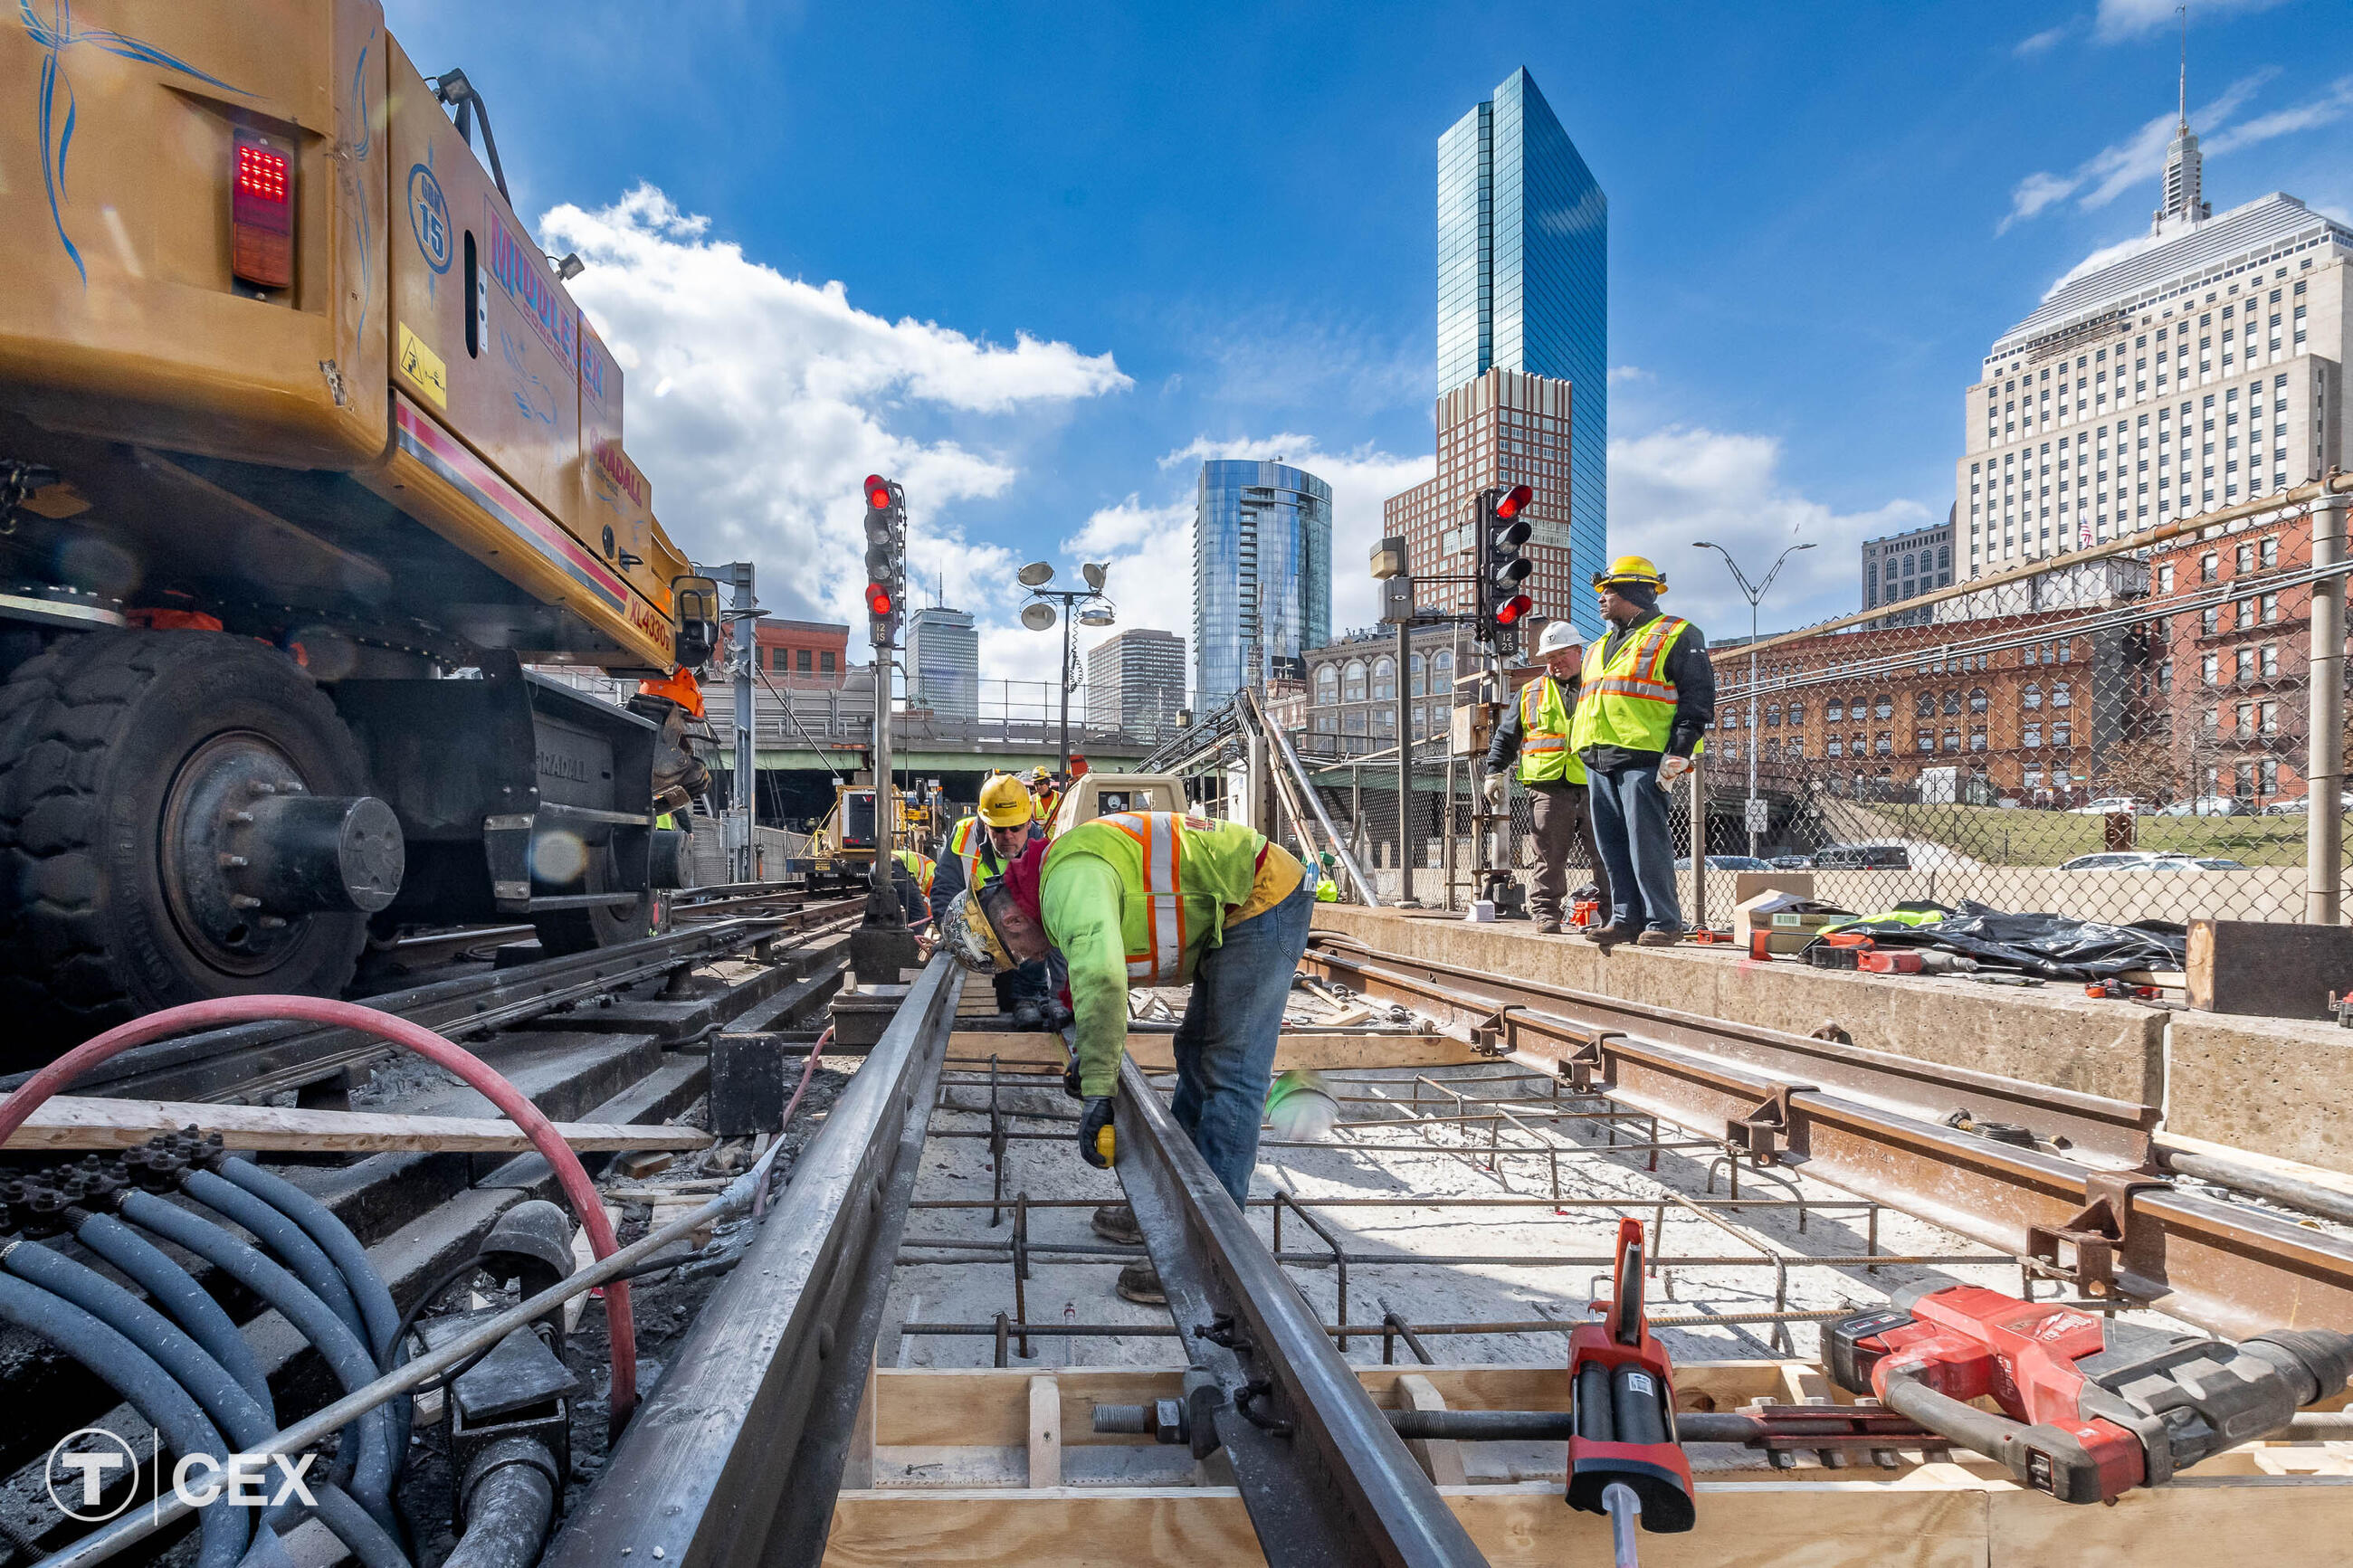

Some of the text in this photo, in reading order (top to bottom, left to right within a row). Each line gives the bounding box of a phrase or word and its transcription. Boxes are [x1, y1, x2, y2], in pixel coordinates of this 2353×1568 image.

[418, 201, 444, 261] 15
[491, 211, 603, 398] MIDDLESEX
[630, 598, 666, 647] XL4330
[876, 622, 886, 632] 12
[1502, 632, 1512, 642] 12
[1501, 642, 1514, 651] 2S
